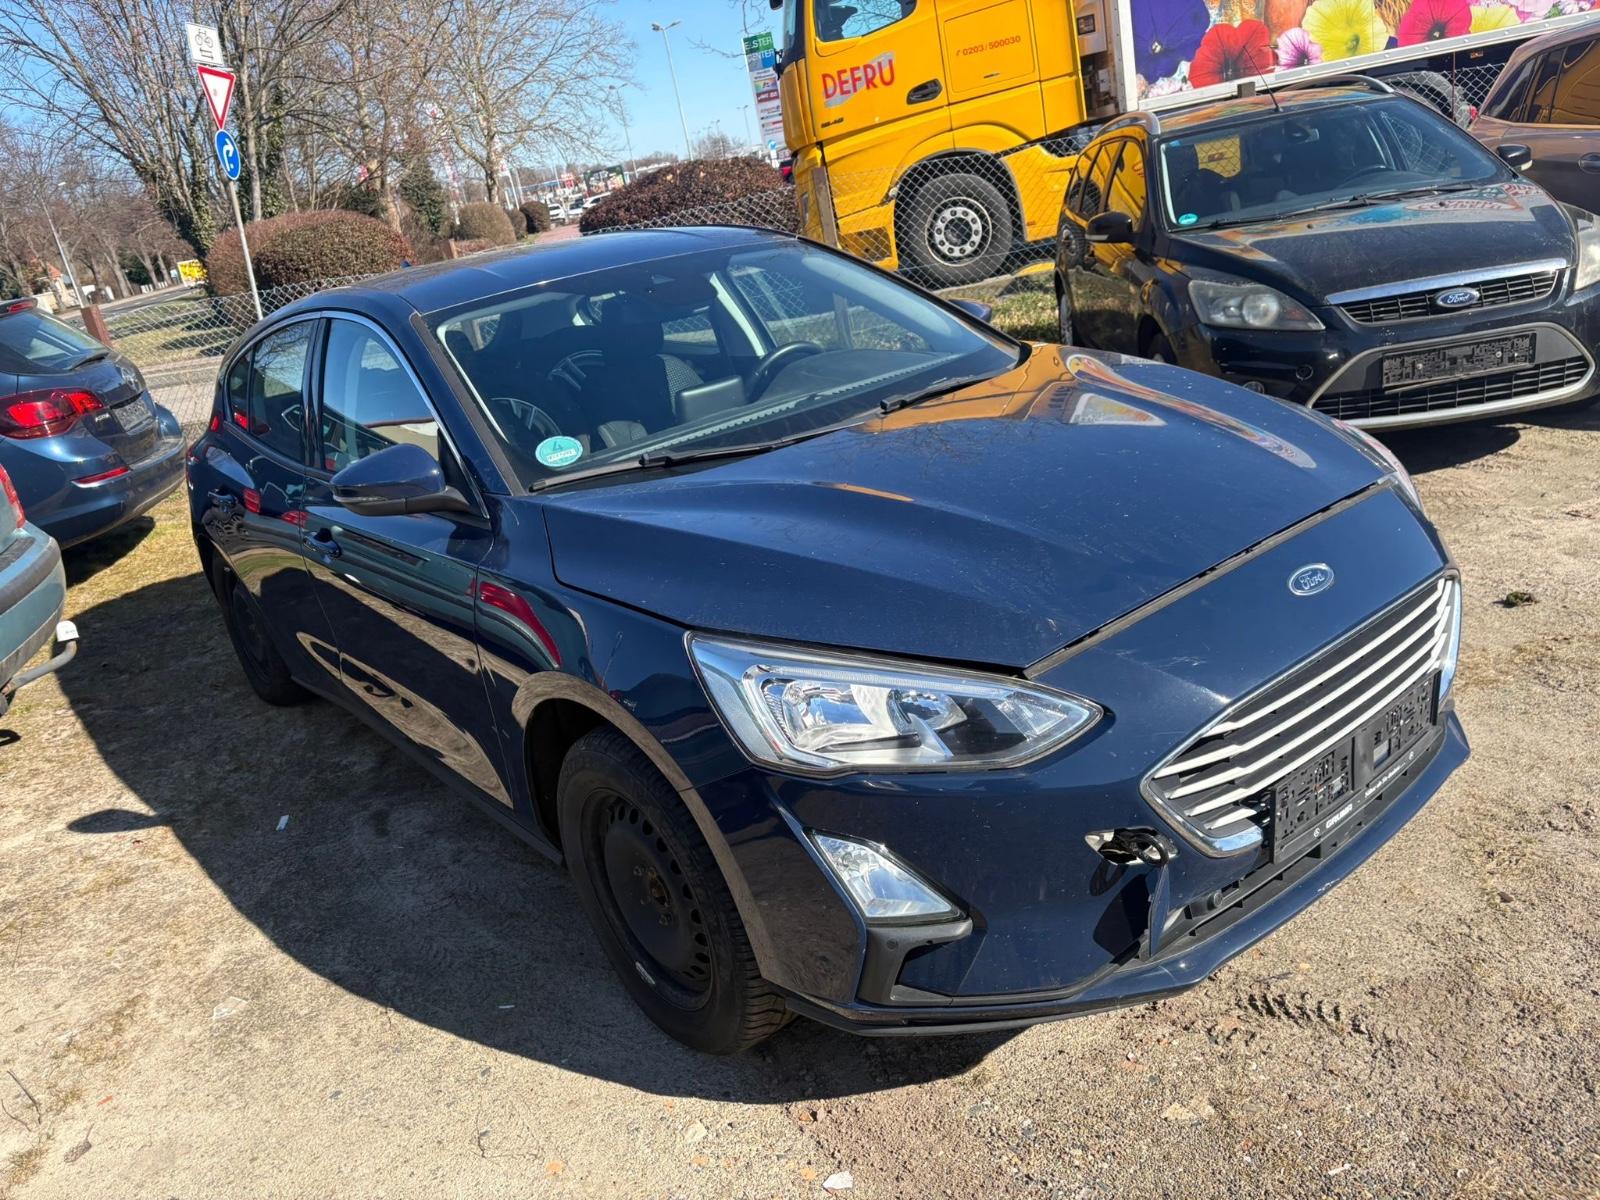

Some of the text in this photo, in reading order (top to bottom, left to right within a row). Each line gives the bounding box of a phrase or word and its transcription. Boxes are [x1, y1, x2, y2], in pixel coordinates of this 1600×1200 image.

[744, 36, 773, 50] ELSTER
[821, 59, 895, 99] DEFRU
[1298, 570, 1326, 590] Ford
